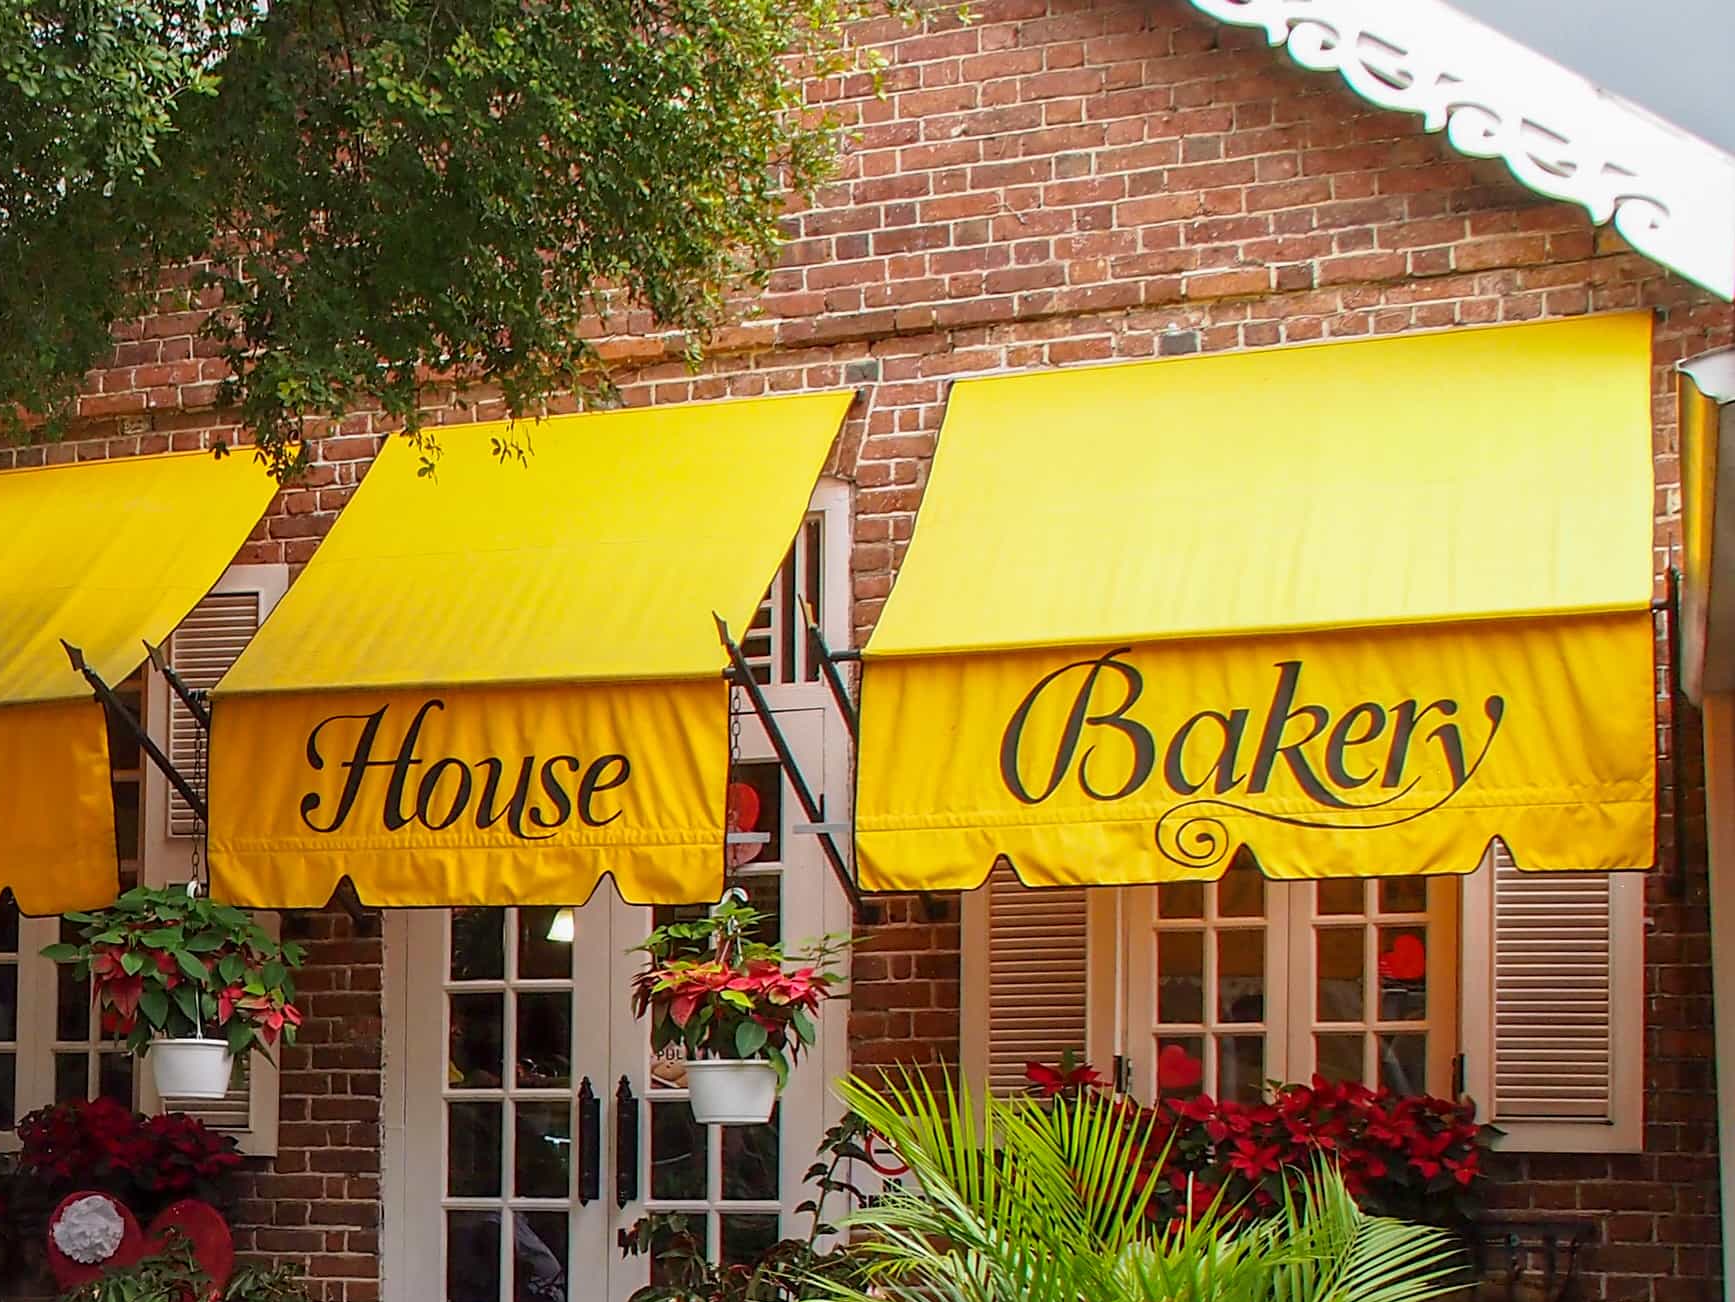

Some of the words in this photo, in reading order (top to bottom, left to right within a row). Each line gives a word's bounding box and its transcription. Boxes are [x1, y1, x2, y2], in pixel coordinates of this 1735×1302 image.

[300, 698, 631, 840] House
[999, 647, 1504, 868] Bakery
[656, 1048, 684, 1061] PUL
